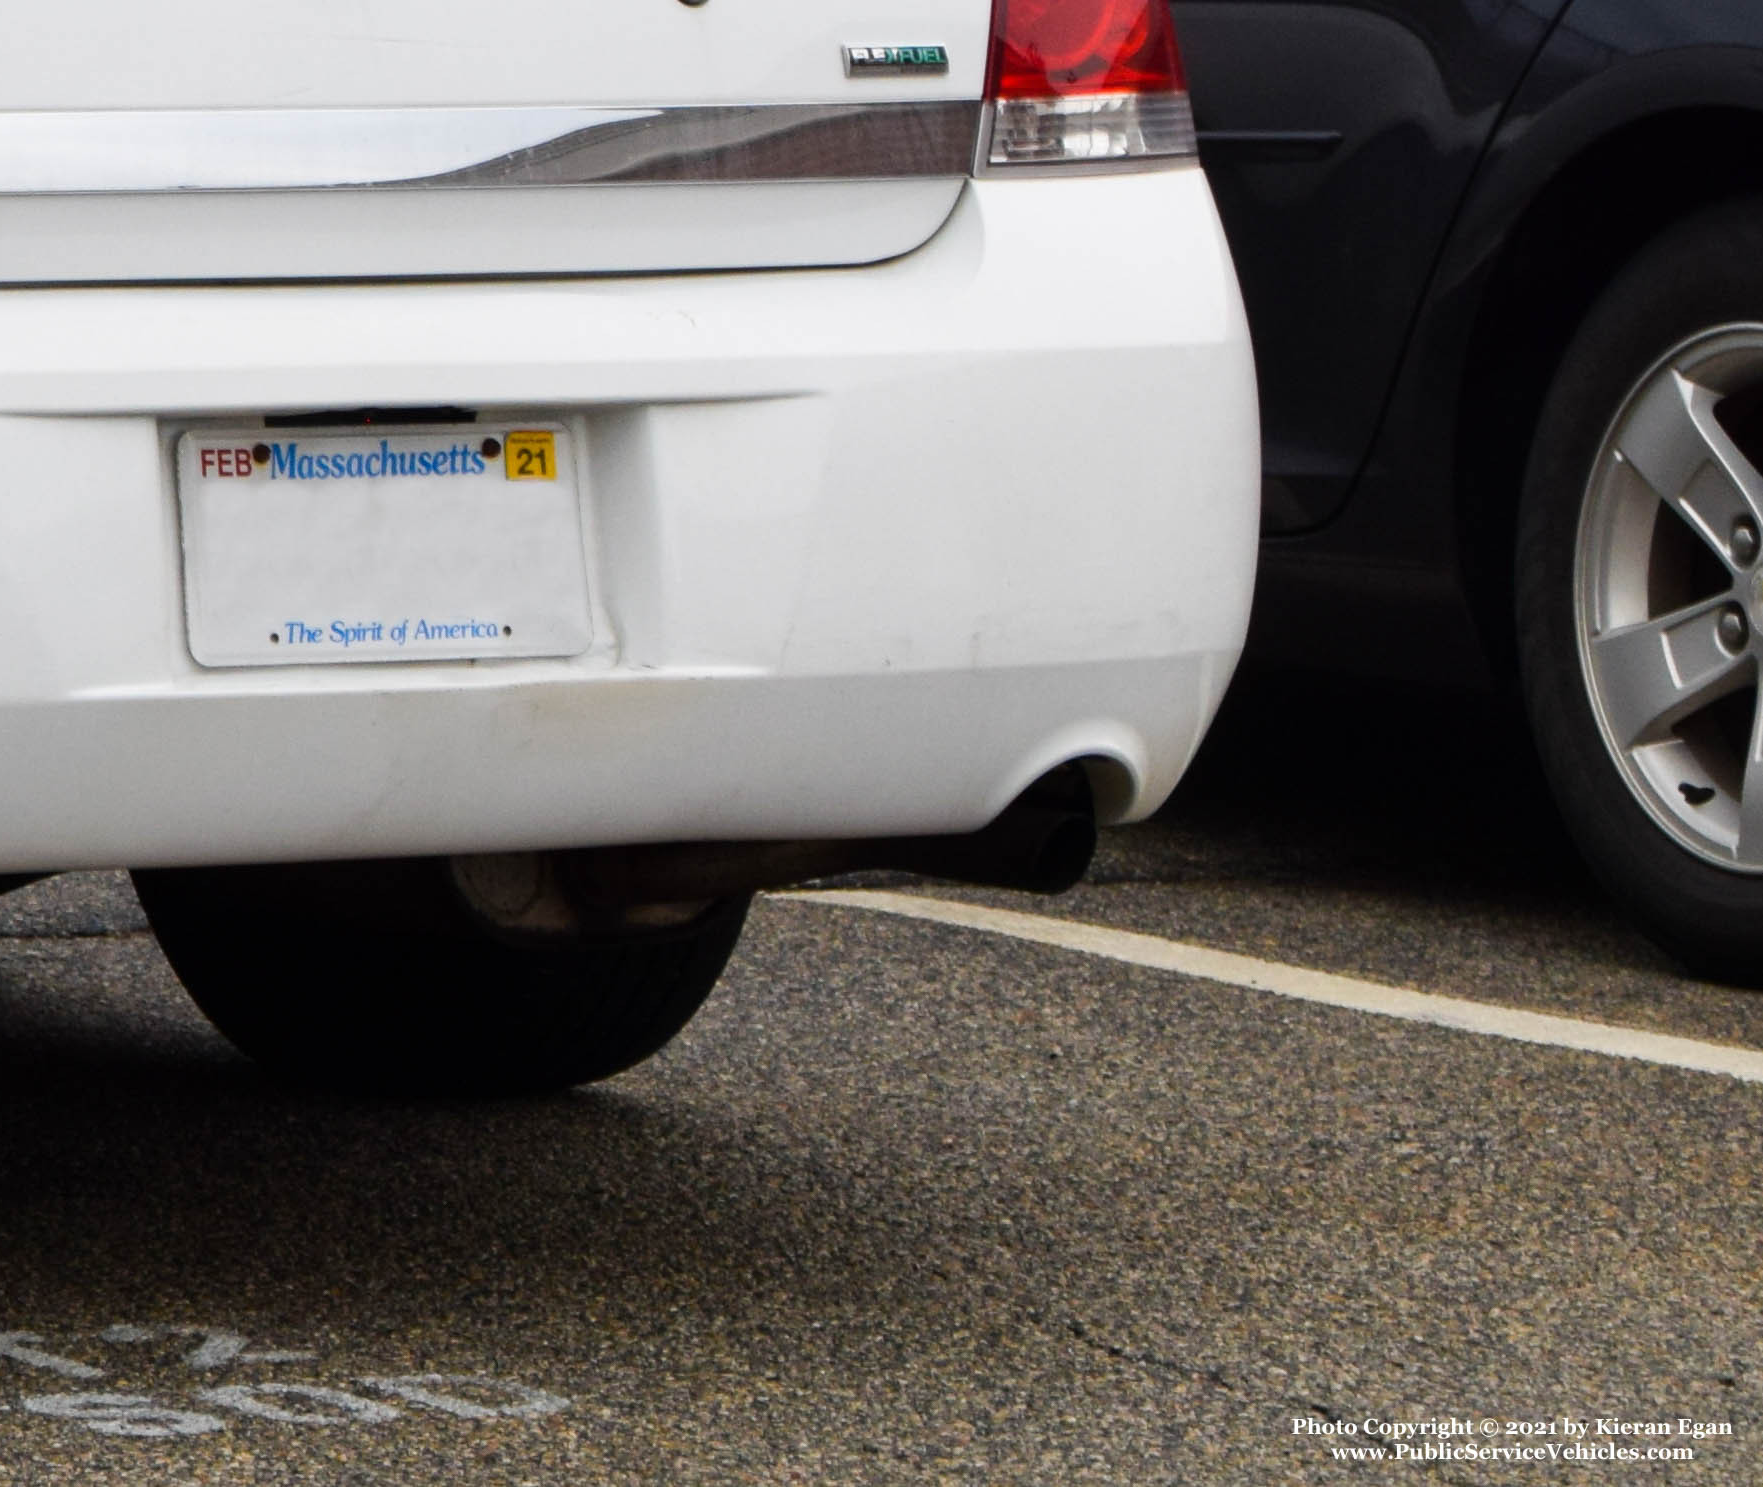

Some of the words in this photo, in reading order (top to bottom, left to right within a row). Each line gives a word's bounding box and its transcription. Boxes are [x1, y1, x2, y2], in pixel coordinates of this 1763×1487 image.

[200, 448, 253, 478] FEB
[270, 440, 486, 480] Massachusetts
[516, 448, 548, 476] 21
[285, 622, 323, 644] The
[329, 621, 383, 647] Spirit
[391, 619, 410, 646] of
[414, 618, 499, 640] America
